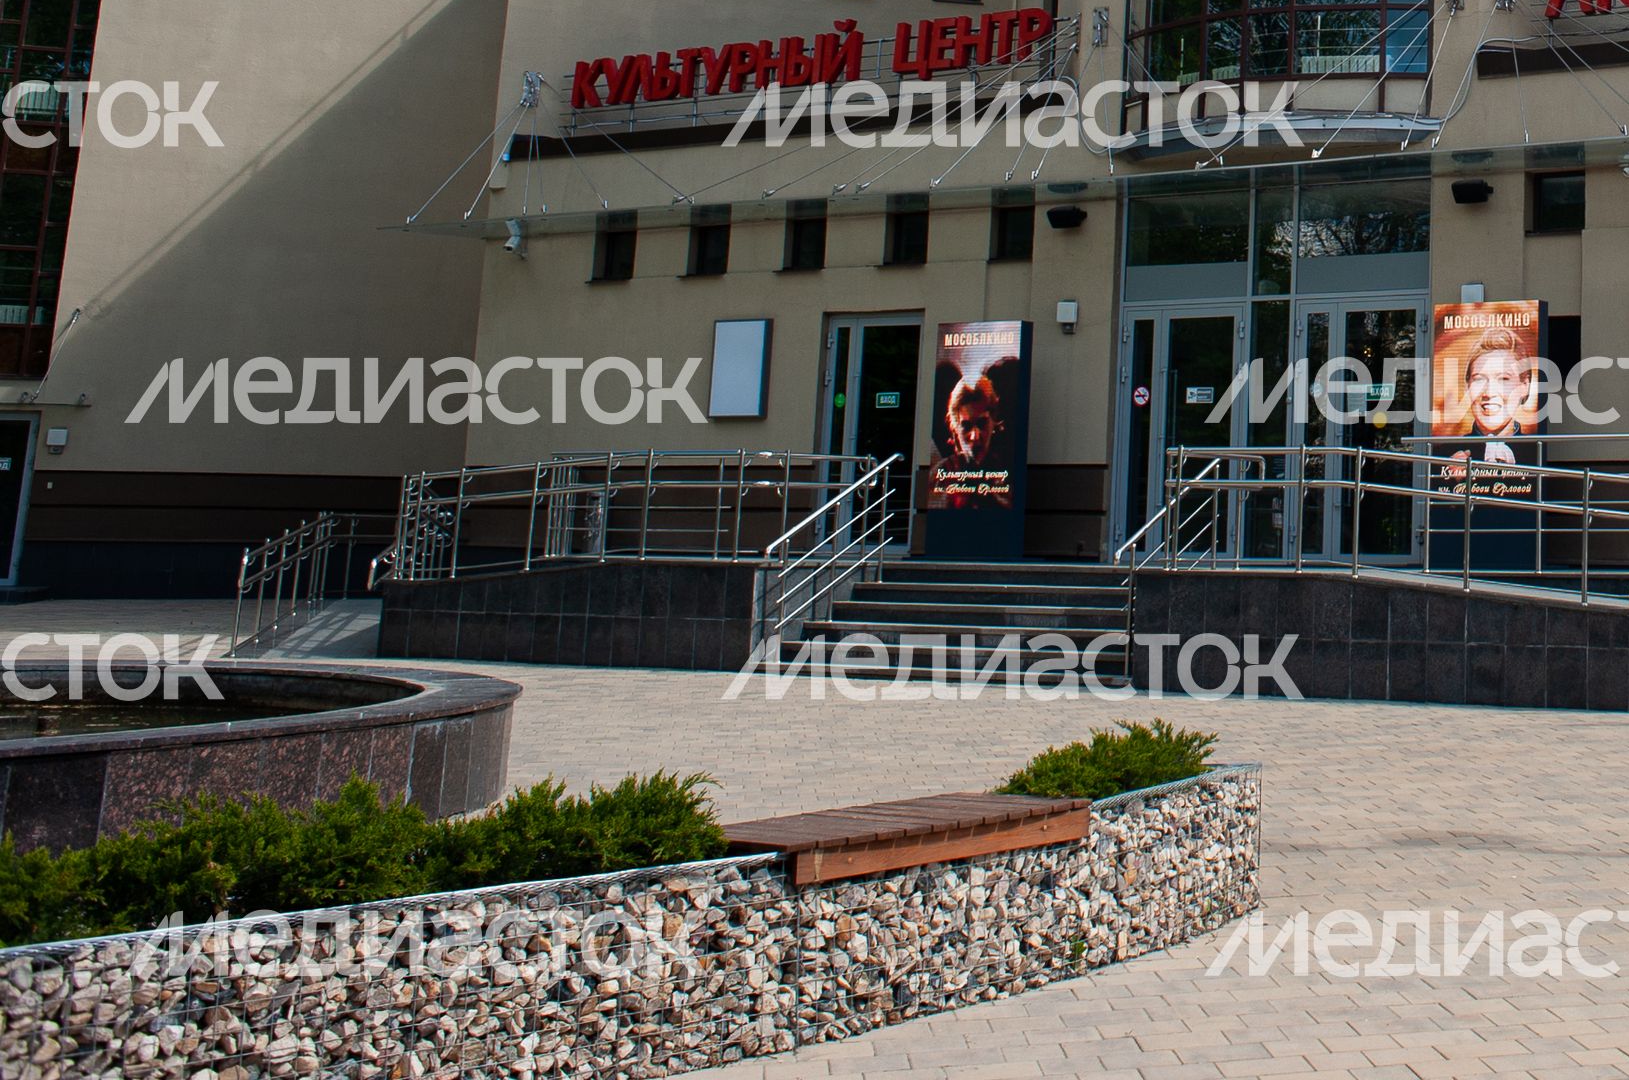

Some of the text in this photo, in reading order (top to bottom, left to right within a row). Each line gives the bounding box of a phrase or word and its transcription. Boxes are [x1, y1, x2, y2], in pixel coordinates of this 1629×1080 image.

[571, 8, 1051, 109] КУЛЬТУРНЫЙ ЦЕНТР
[1444, 313, 1530, 329] МОСОБЛКИНО
[944, 332, 1014, 346] МОСОБЛКИНО
